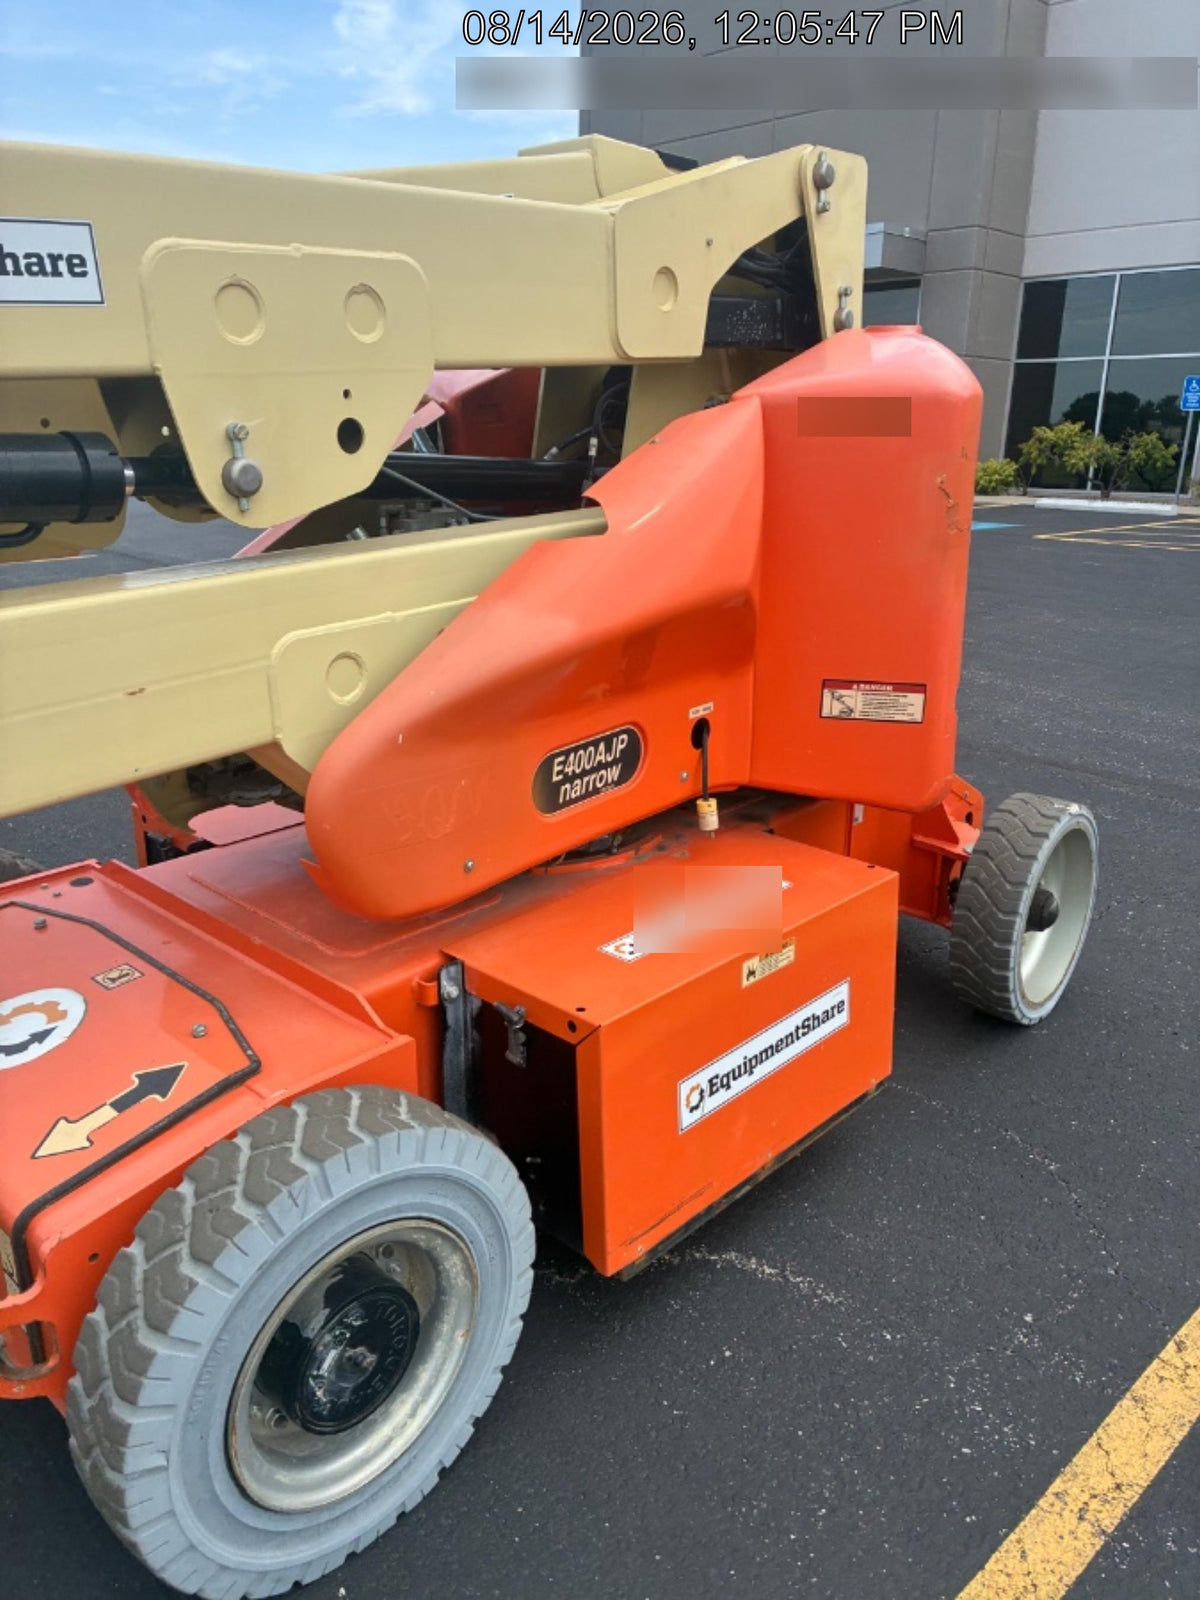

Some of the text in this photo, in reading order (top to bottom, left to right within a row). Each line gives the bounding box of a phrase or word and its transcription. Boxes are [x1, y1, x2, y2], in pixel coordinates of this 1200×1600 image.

[552, 734, 629, 783] E400AJP
[559, 763, 623, 804] narrow
[707, 998, 846, 1098] EquipmentShare
